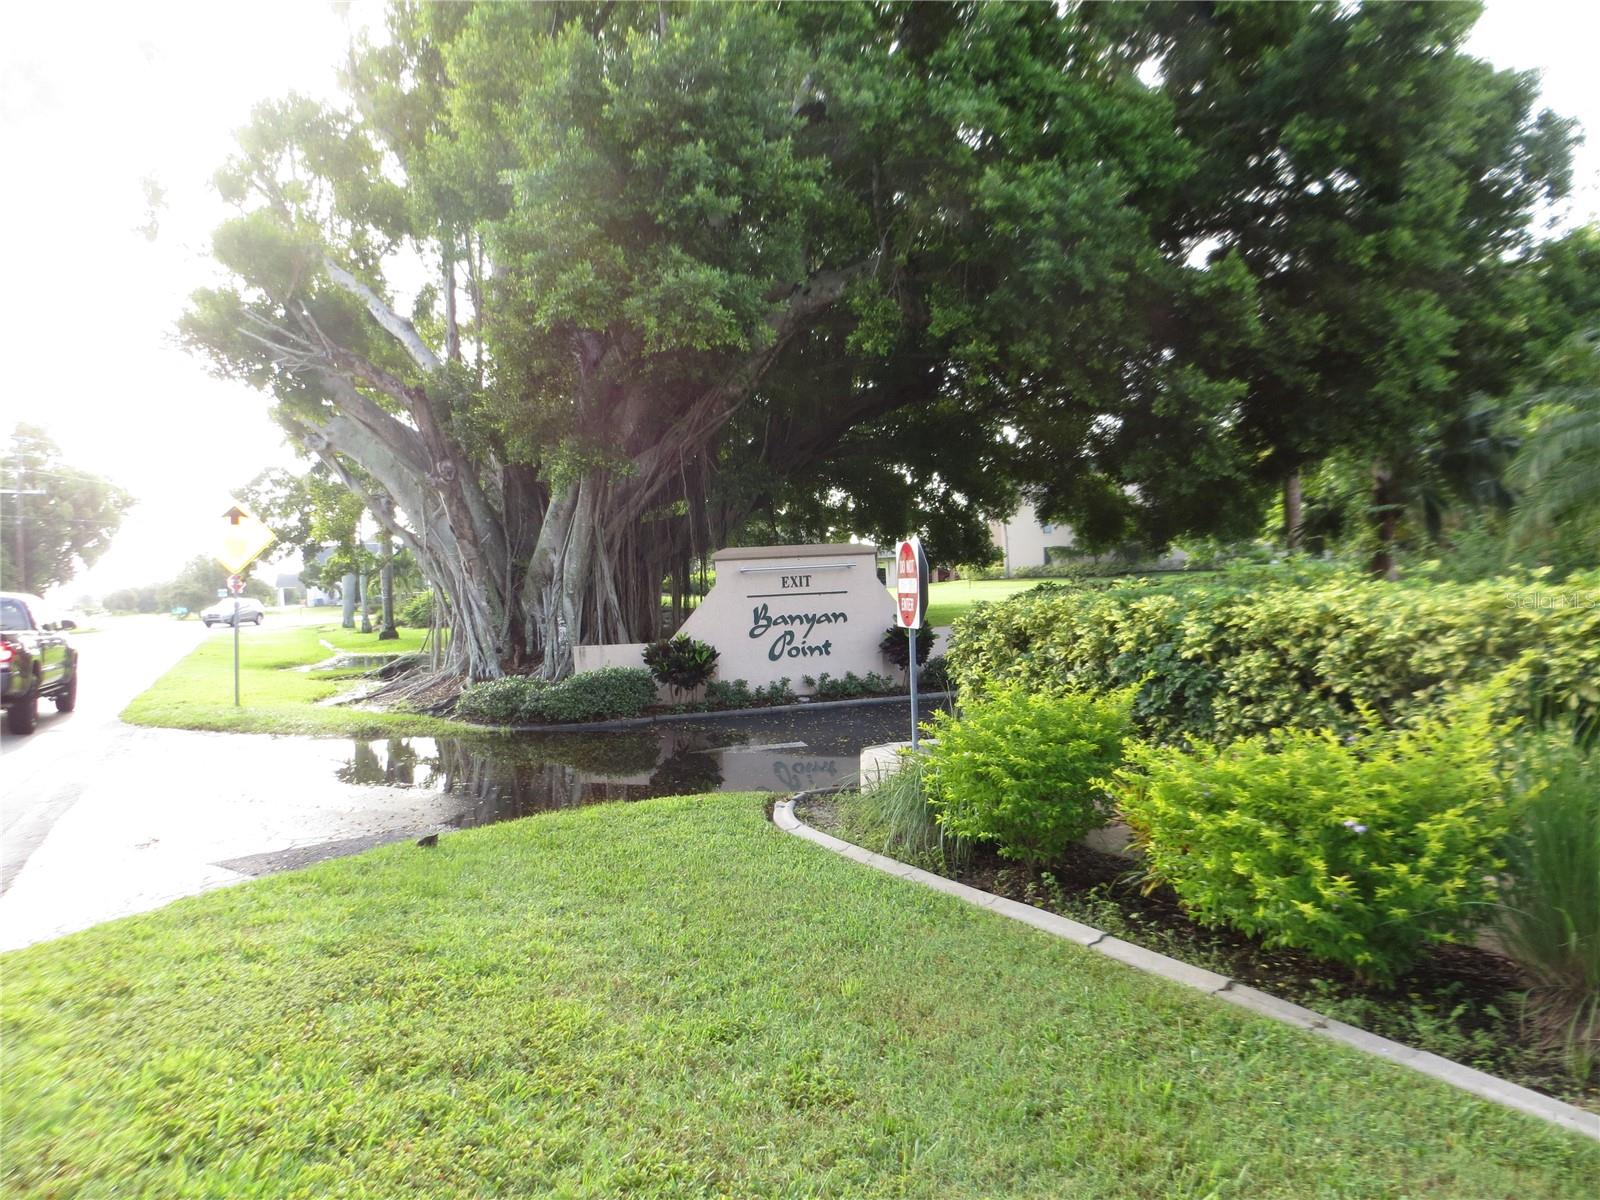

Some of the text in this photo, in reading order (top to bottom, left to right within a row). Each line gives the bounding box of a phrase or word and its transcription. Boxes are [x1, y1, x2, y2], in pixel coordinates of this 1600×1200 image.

[781, 575, 812, 588] EXIT
[749, 603, 848, 639] Banyan
[768, 630, 832, 661] Point
